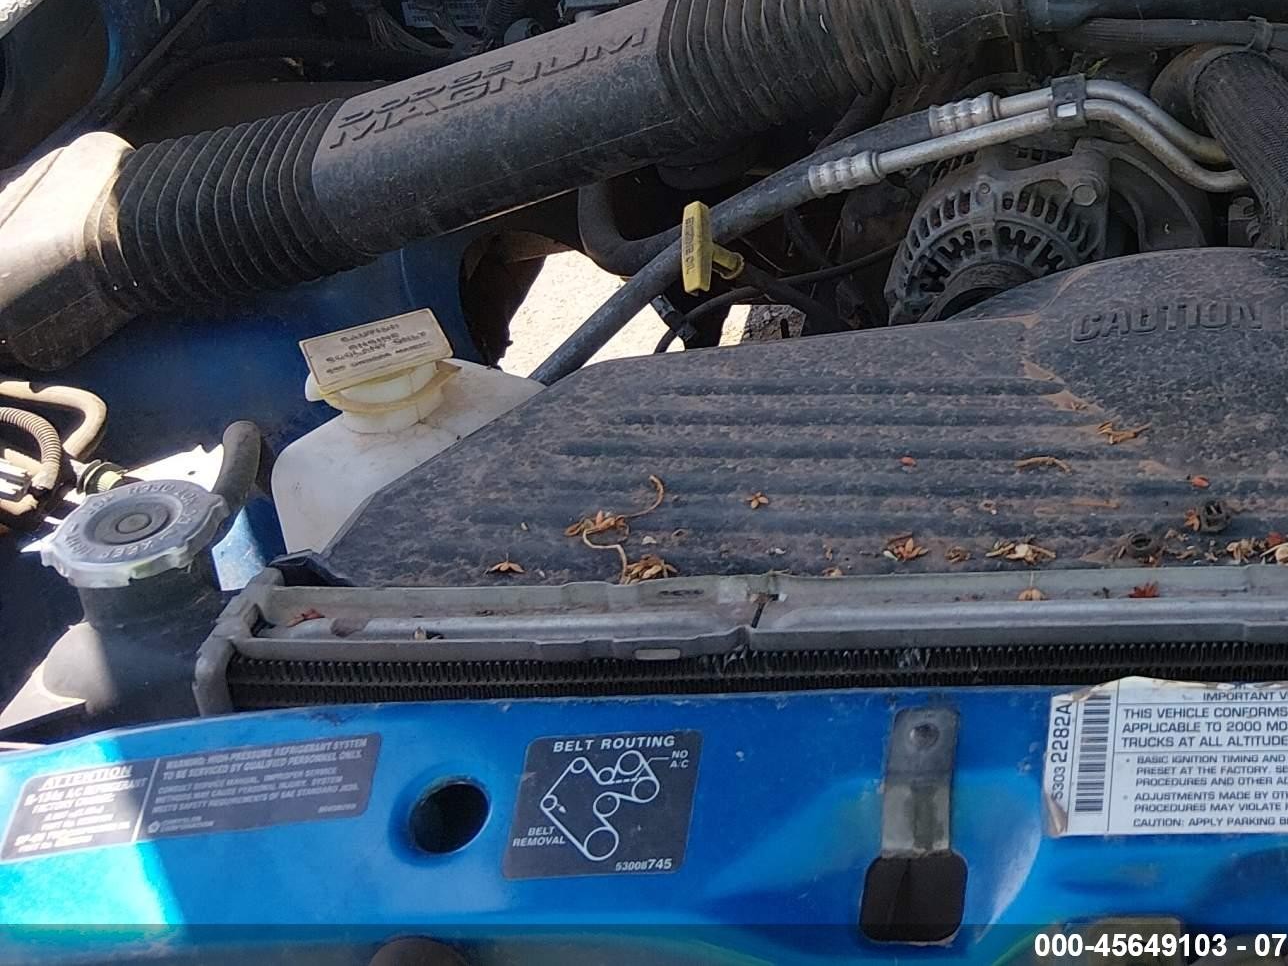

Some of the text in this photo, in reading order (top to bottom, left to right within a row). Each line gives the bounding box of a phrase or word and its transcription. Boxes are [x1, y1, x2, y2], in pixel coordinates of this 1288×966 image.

[329, 28, 648, 150] DODGE MAGNUM
[1070, 297, 1265, 344] CAUTION
[1203, 692, 1274, 702] IMPORTANT
[1124, 708, 1151, 718] THIS
[1157, 707, 1208, 718] VEHICLE
[1214, 706, 1287, 718] CONFORMS
[1122, 722, 1199, 733] APPLICABLE
[1206, 722, 1221, 731] TO
[1226, 721, 1261, 731] 2000
[553, 735, 675, 752] BELT ROUTING
[1121, 736, 1173, 747] TRUCKS
[1178, 736, 1195, 746] AT
[1199, 736, 1222, 746] ALL
[671, 750, 688, 759] NO
[1172, 755, 1218, 763] IGNITION
[1262, 754, 1286, 762] AND
[669, 759, 689, 768] A/C
[1180, 766, 1193, 774] AT
[1198, 766, 1216, 774] THE
[1220, 766, 1269, 774] FACTORY.
[40, 765, 133, 789] ATTENTION
[1136, 777, 1207, 786] PROCEDURES
[1210, 777, 1235, 785] AND
[1238, 777, 1273, 785] OTHER
[1134, 791, 1215, 800] ADJUSTMENTS
[1219, 791, 1250, 799] MADE
[1134, 803, 1206, 812] PROCEDURES
[1210, 803, 1235, 811] MAY
[1133, 818, 1185, 826] CAUTION:
[1188, 818, 1223, 826] APPLY
[1227, 817, 1275, 825] PARKING
[528, 826, 556, 835] BELT
[512, 836, 566, 847] REMOVAL
